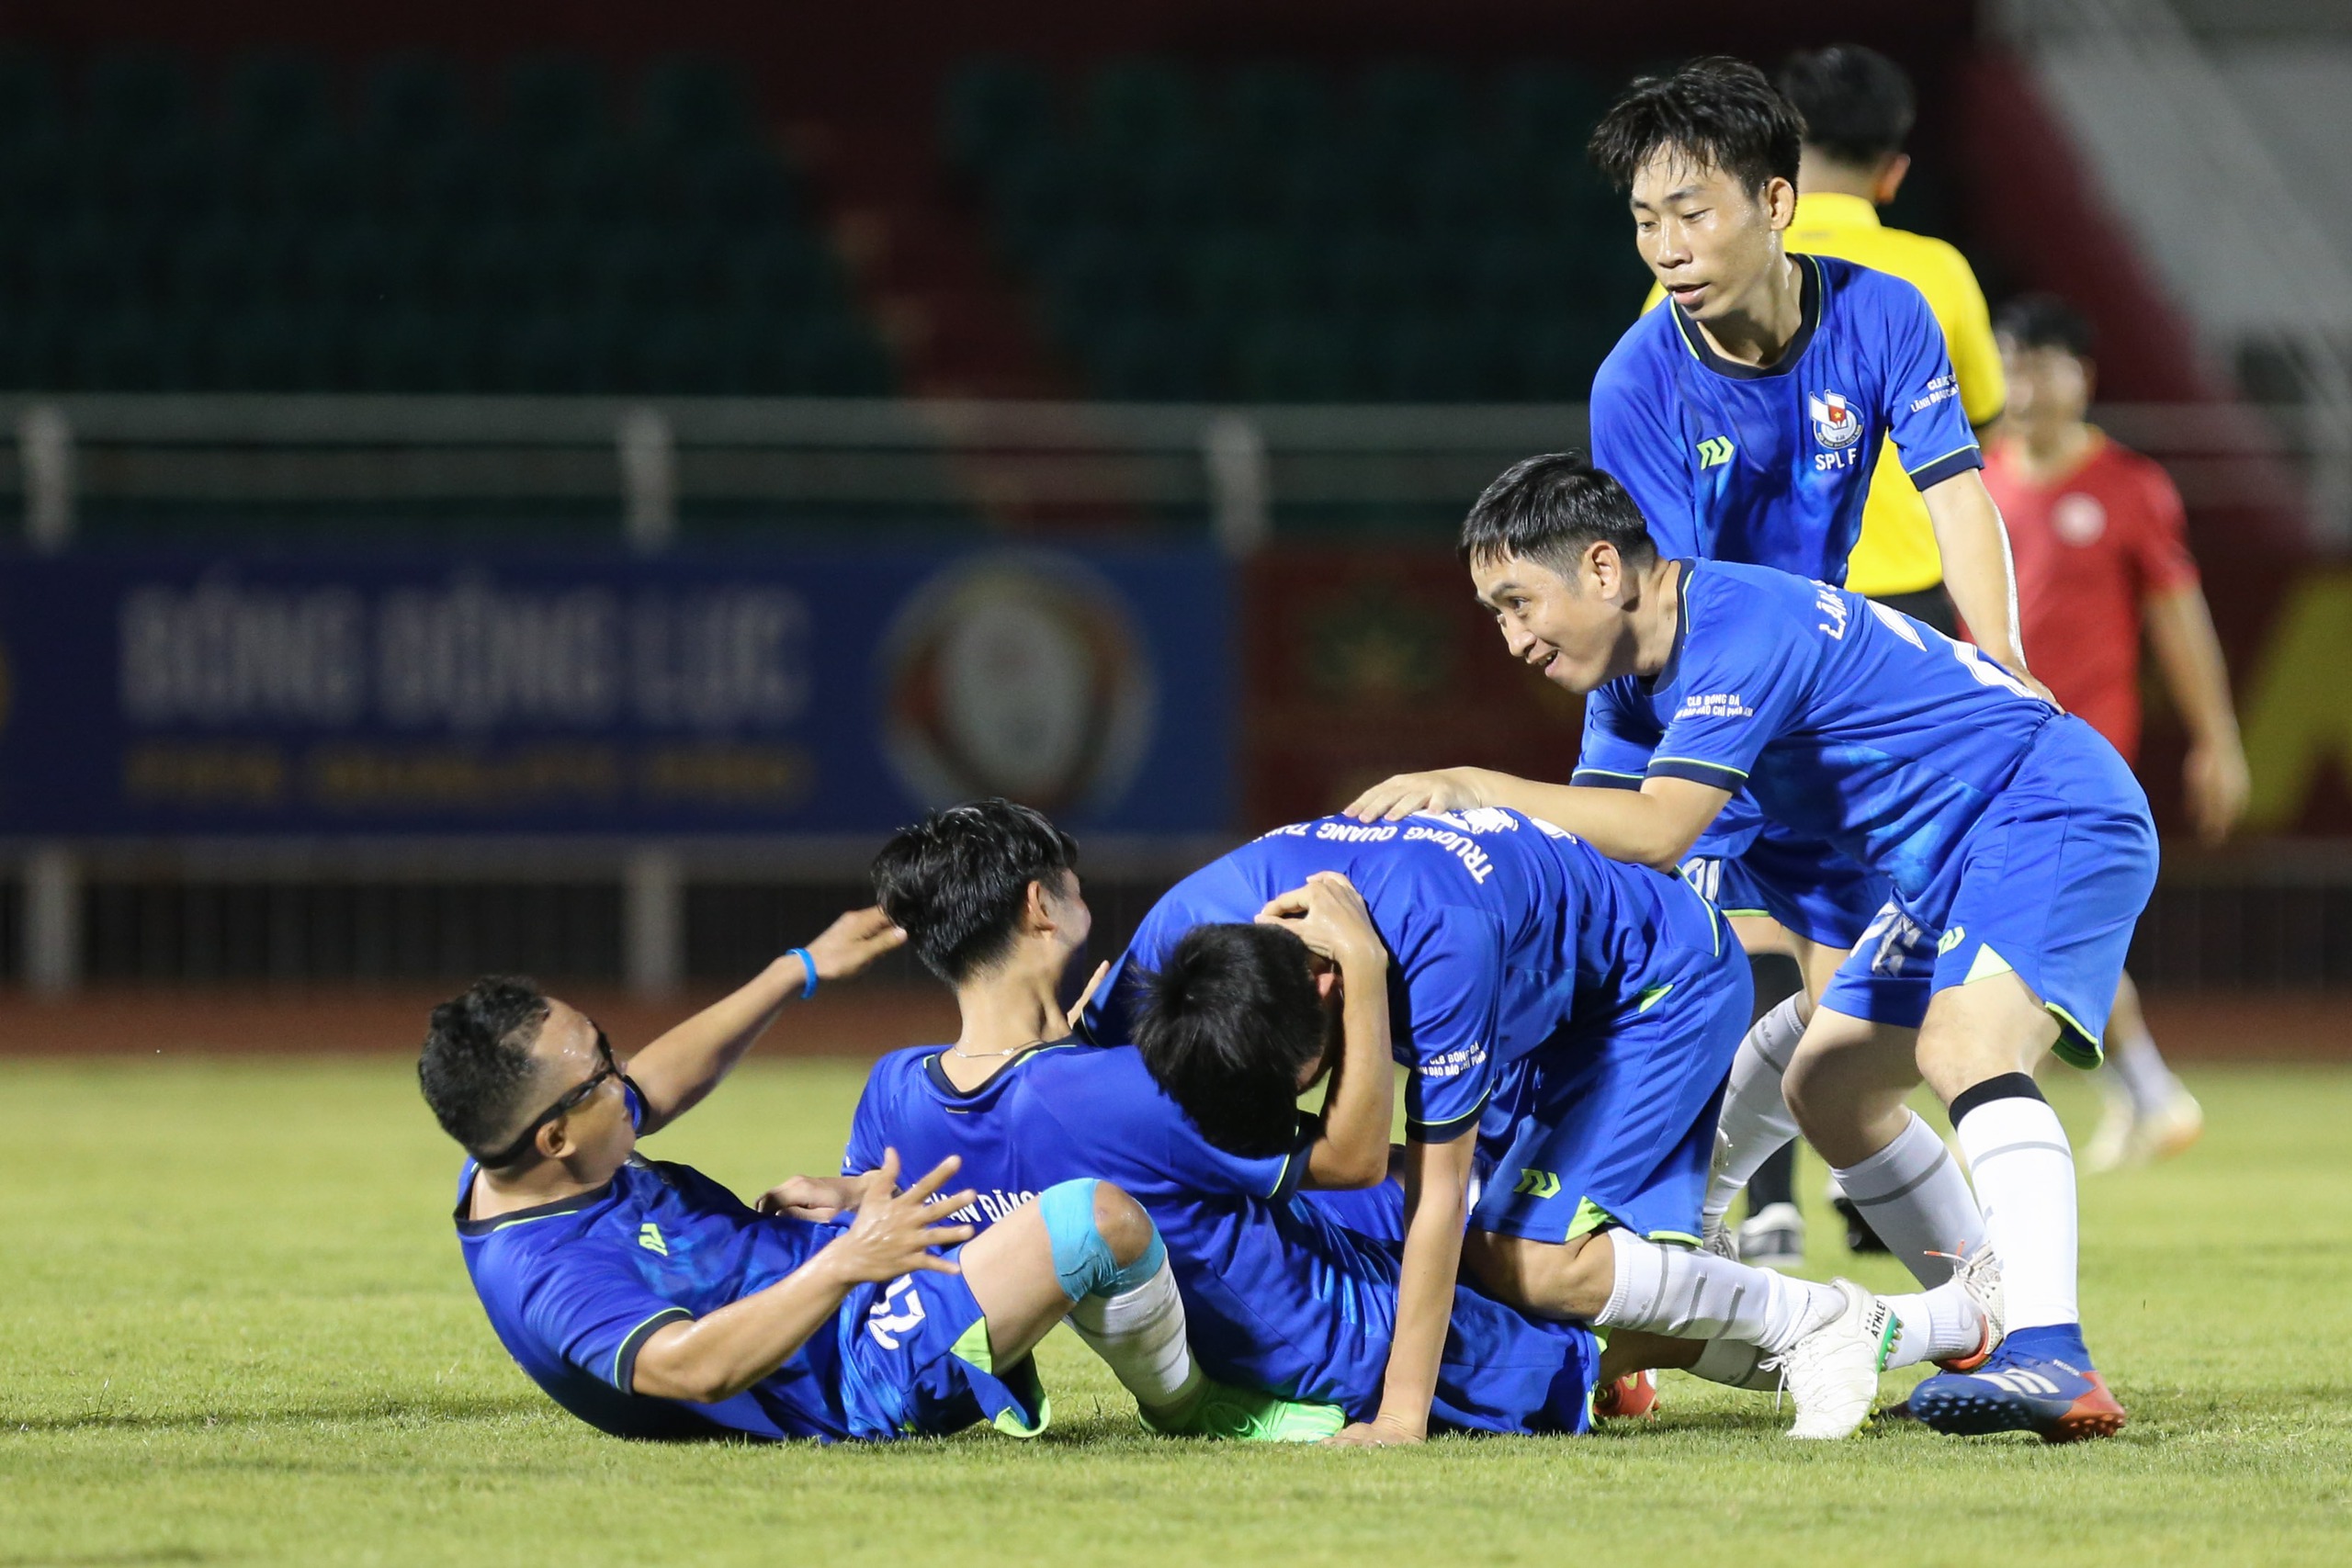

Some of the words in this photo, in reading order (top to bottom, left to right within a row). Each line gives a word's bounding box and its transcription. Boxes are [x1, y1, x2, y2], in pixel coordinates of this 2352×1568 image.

[1815, 451, 1845, 471] SPL
[1847, 448, 1857, 465] F
[1316, 822, 1398, 843] QUANG
[1871, 1300, 1886, 1340] ATHLE
